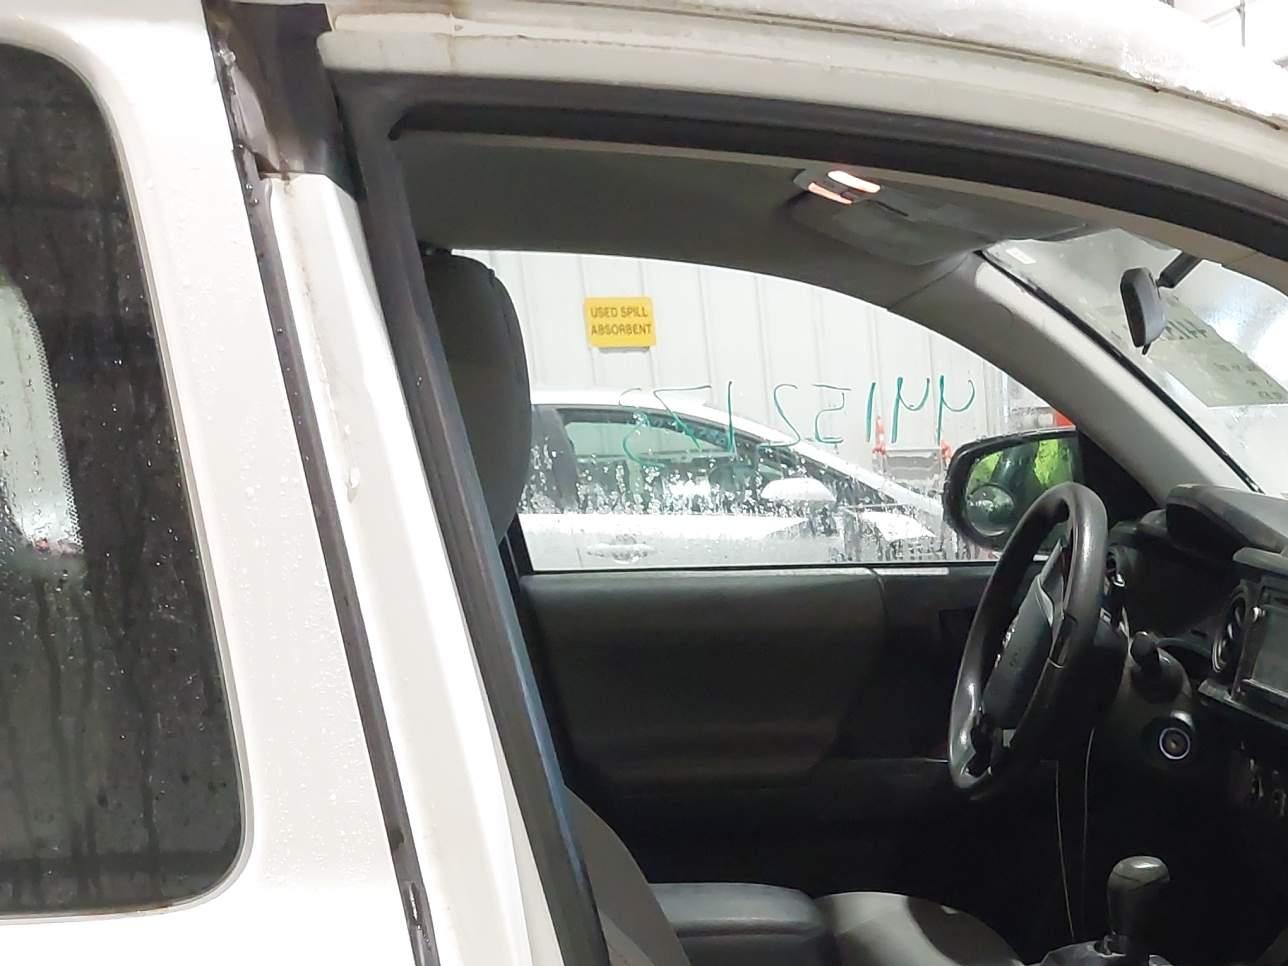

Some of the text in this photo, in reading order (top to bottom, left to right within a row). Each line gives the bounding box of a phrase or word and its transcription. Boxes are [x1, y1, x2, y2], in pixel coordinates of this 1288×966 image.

[590, 306, 649, 318] USED SPILL
[591, 323, 652, 336] ABSORBENT
